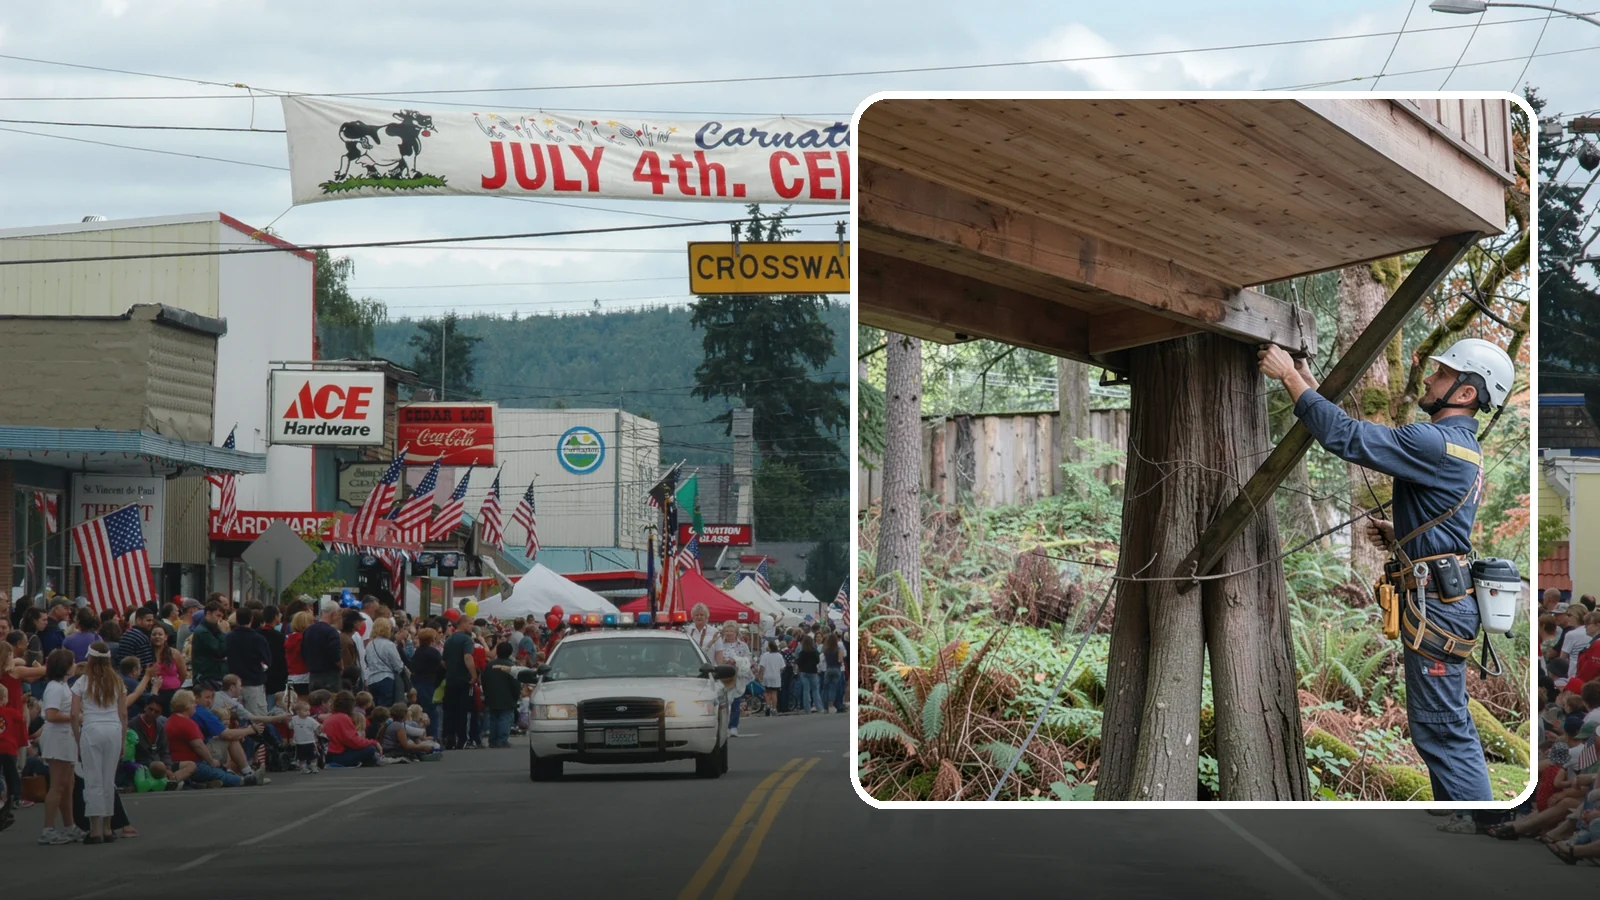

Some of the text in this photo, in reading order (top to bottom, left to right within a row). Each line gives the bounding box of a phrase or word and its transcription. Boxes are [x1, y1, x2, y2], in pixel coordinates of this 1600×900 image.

[695, 121, 850, 150] Carnat
[481, 141, 605, 192] JULY
[632, 150, 747, 198] 4th.
[696, 254, 850, 280] CROSSWA
[282, 380, 374, 420] ACE
[405, 408, 486, 422] CEDAR LOG
[283, 421, 371, 437] Hardware
[353, 466, 385, 480] Simpl
[83, 484, 155, 495] St. Vincent de Paul
[81, 503, 154, 522] THT
[688, 526, 741, 535] CRNATION
[699, 535, 730, 543] GLASS
